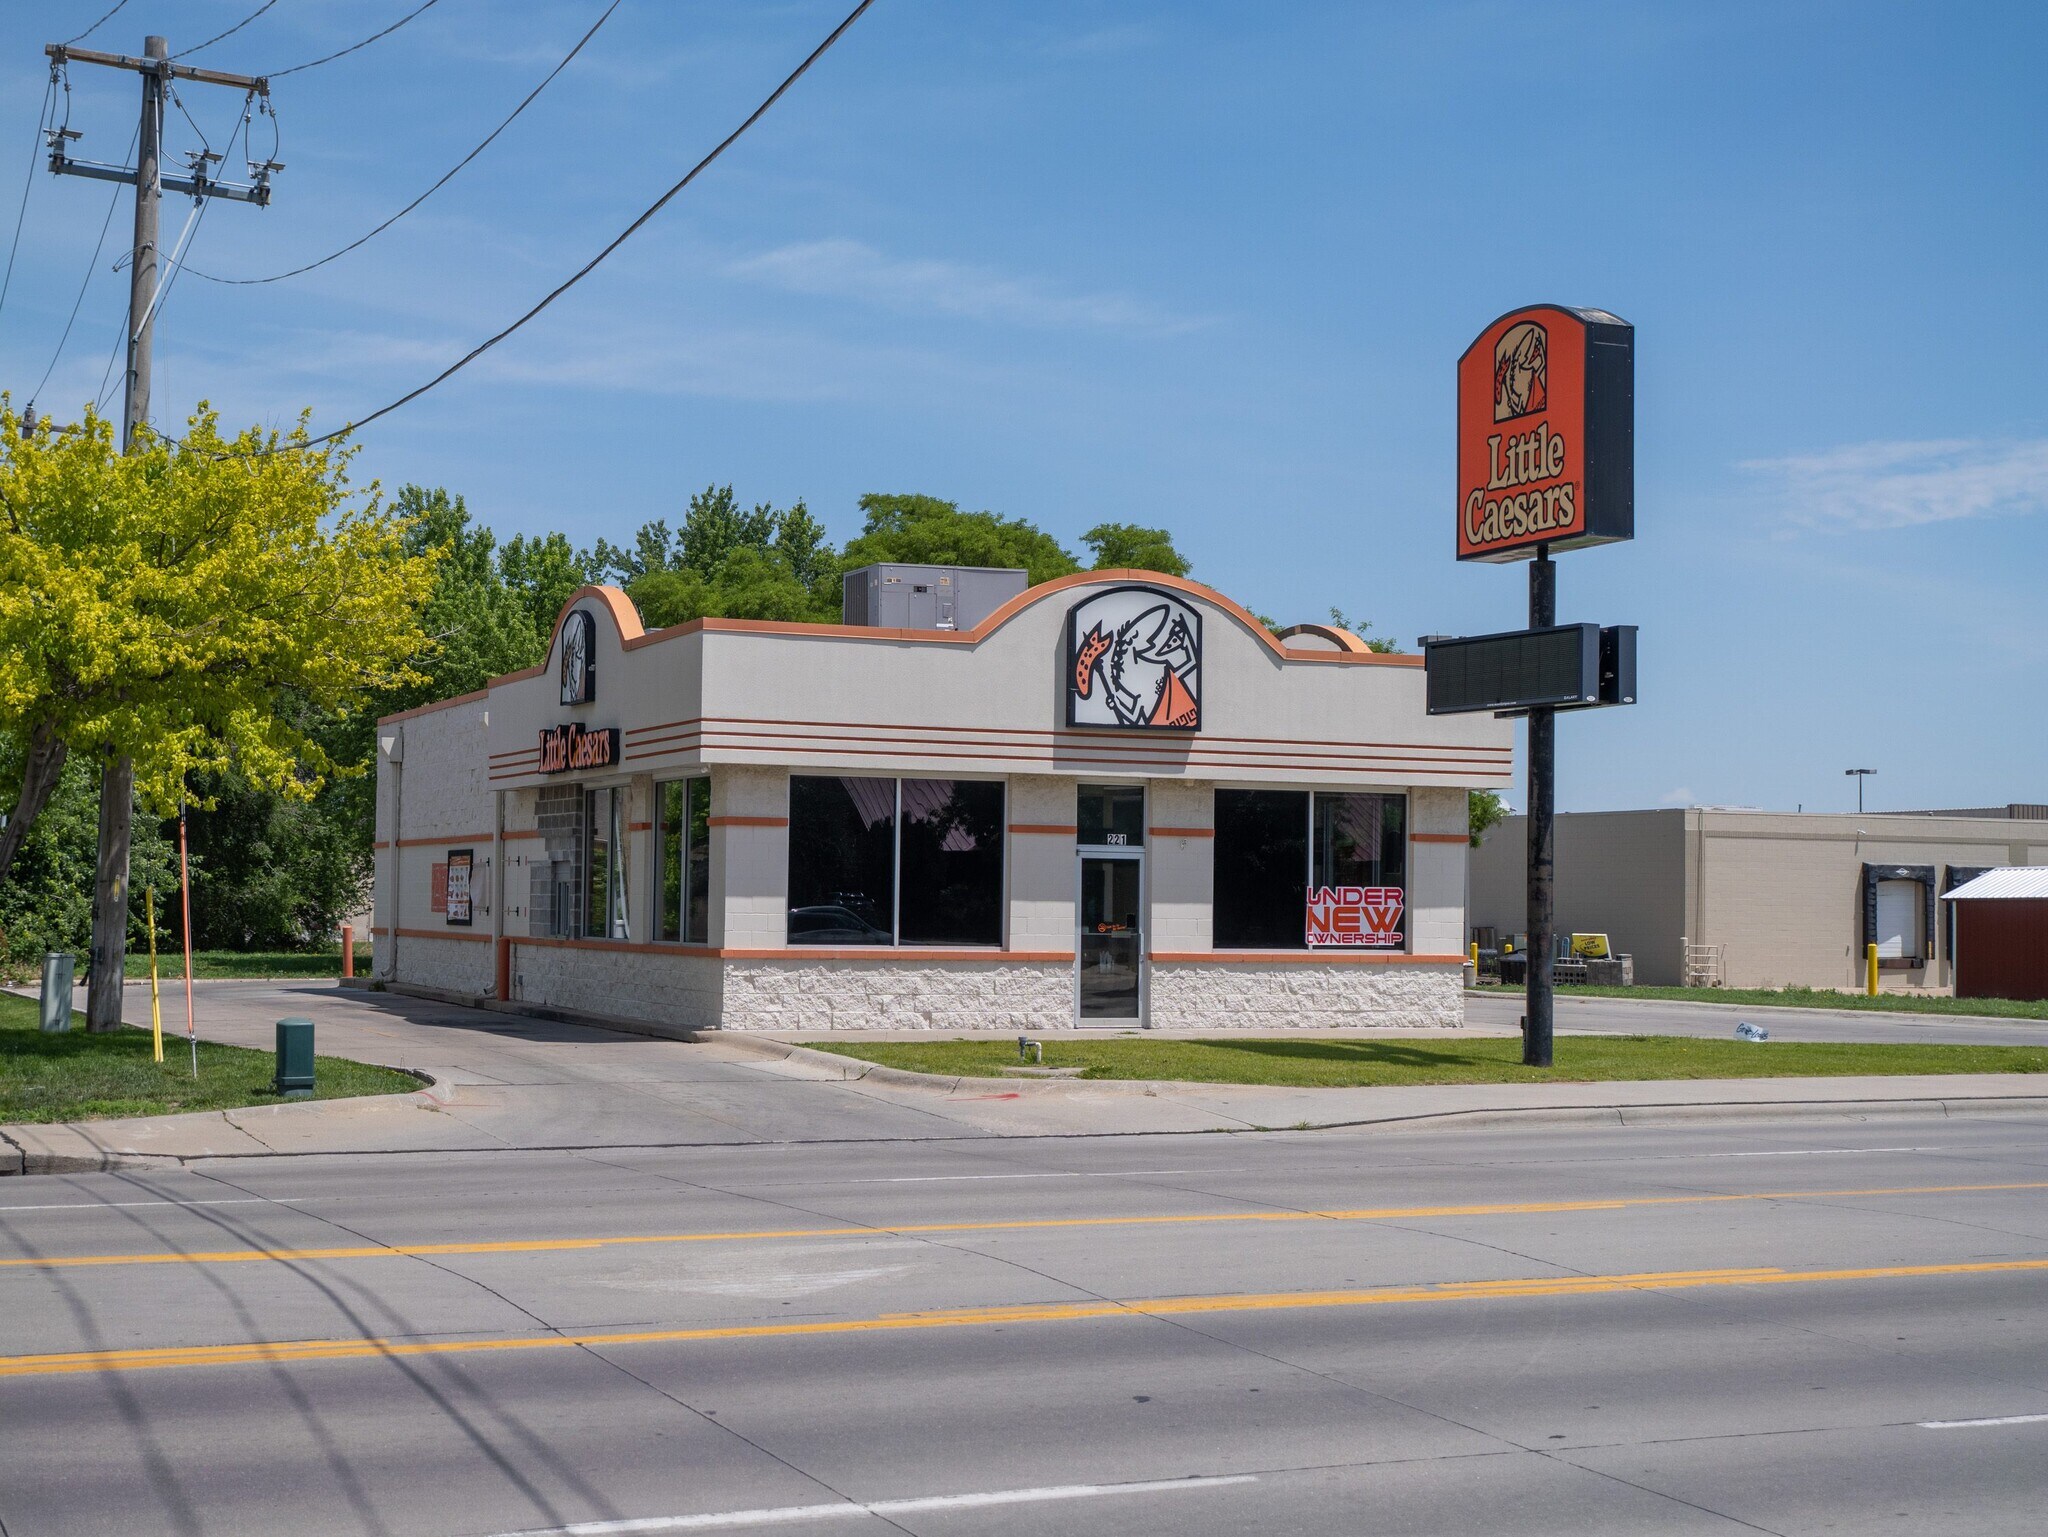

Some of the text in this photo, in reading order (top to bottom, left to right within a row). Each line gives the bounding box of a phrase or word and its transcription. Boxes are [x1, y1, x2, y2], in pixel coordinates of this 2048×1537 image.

[1487, 421, 1565, 491] Little
[1465, 482, 1575, 545] Caesars
[539, 723, 610, 773] Little Caesars
[1108, 834, 1126, 845] 221
[1307, 887, 1403, 906] UNDER
[1307, 906, 1402, 932] NEW
[1306, 933, 1402, 944] OWNERSHIP
